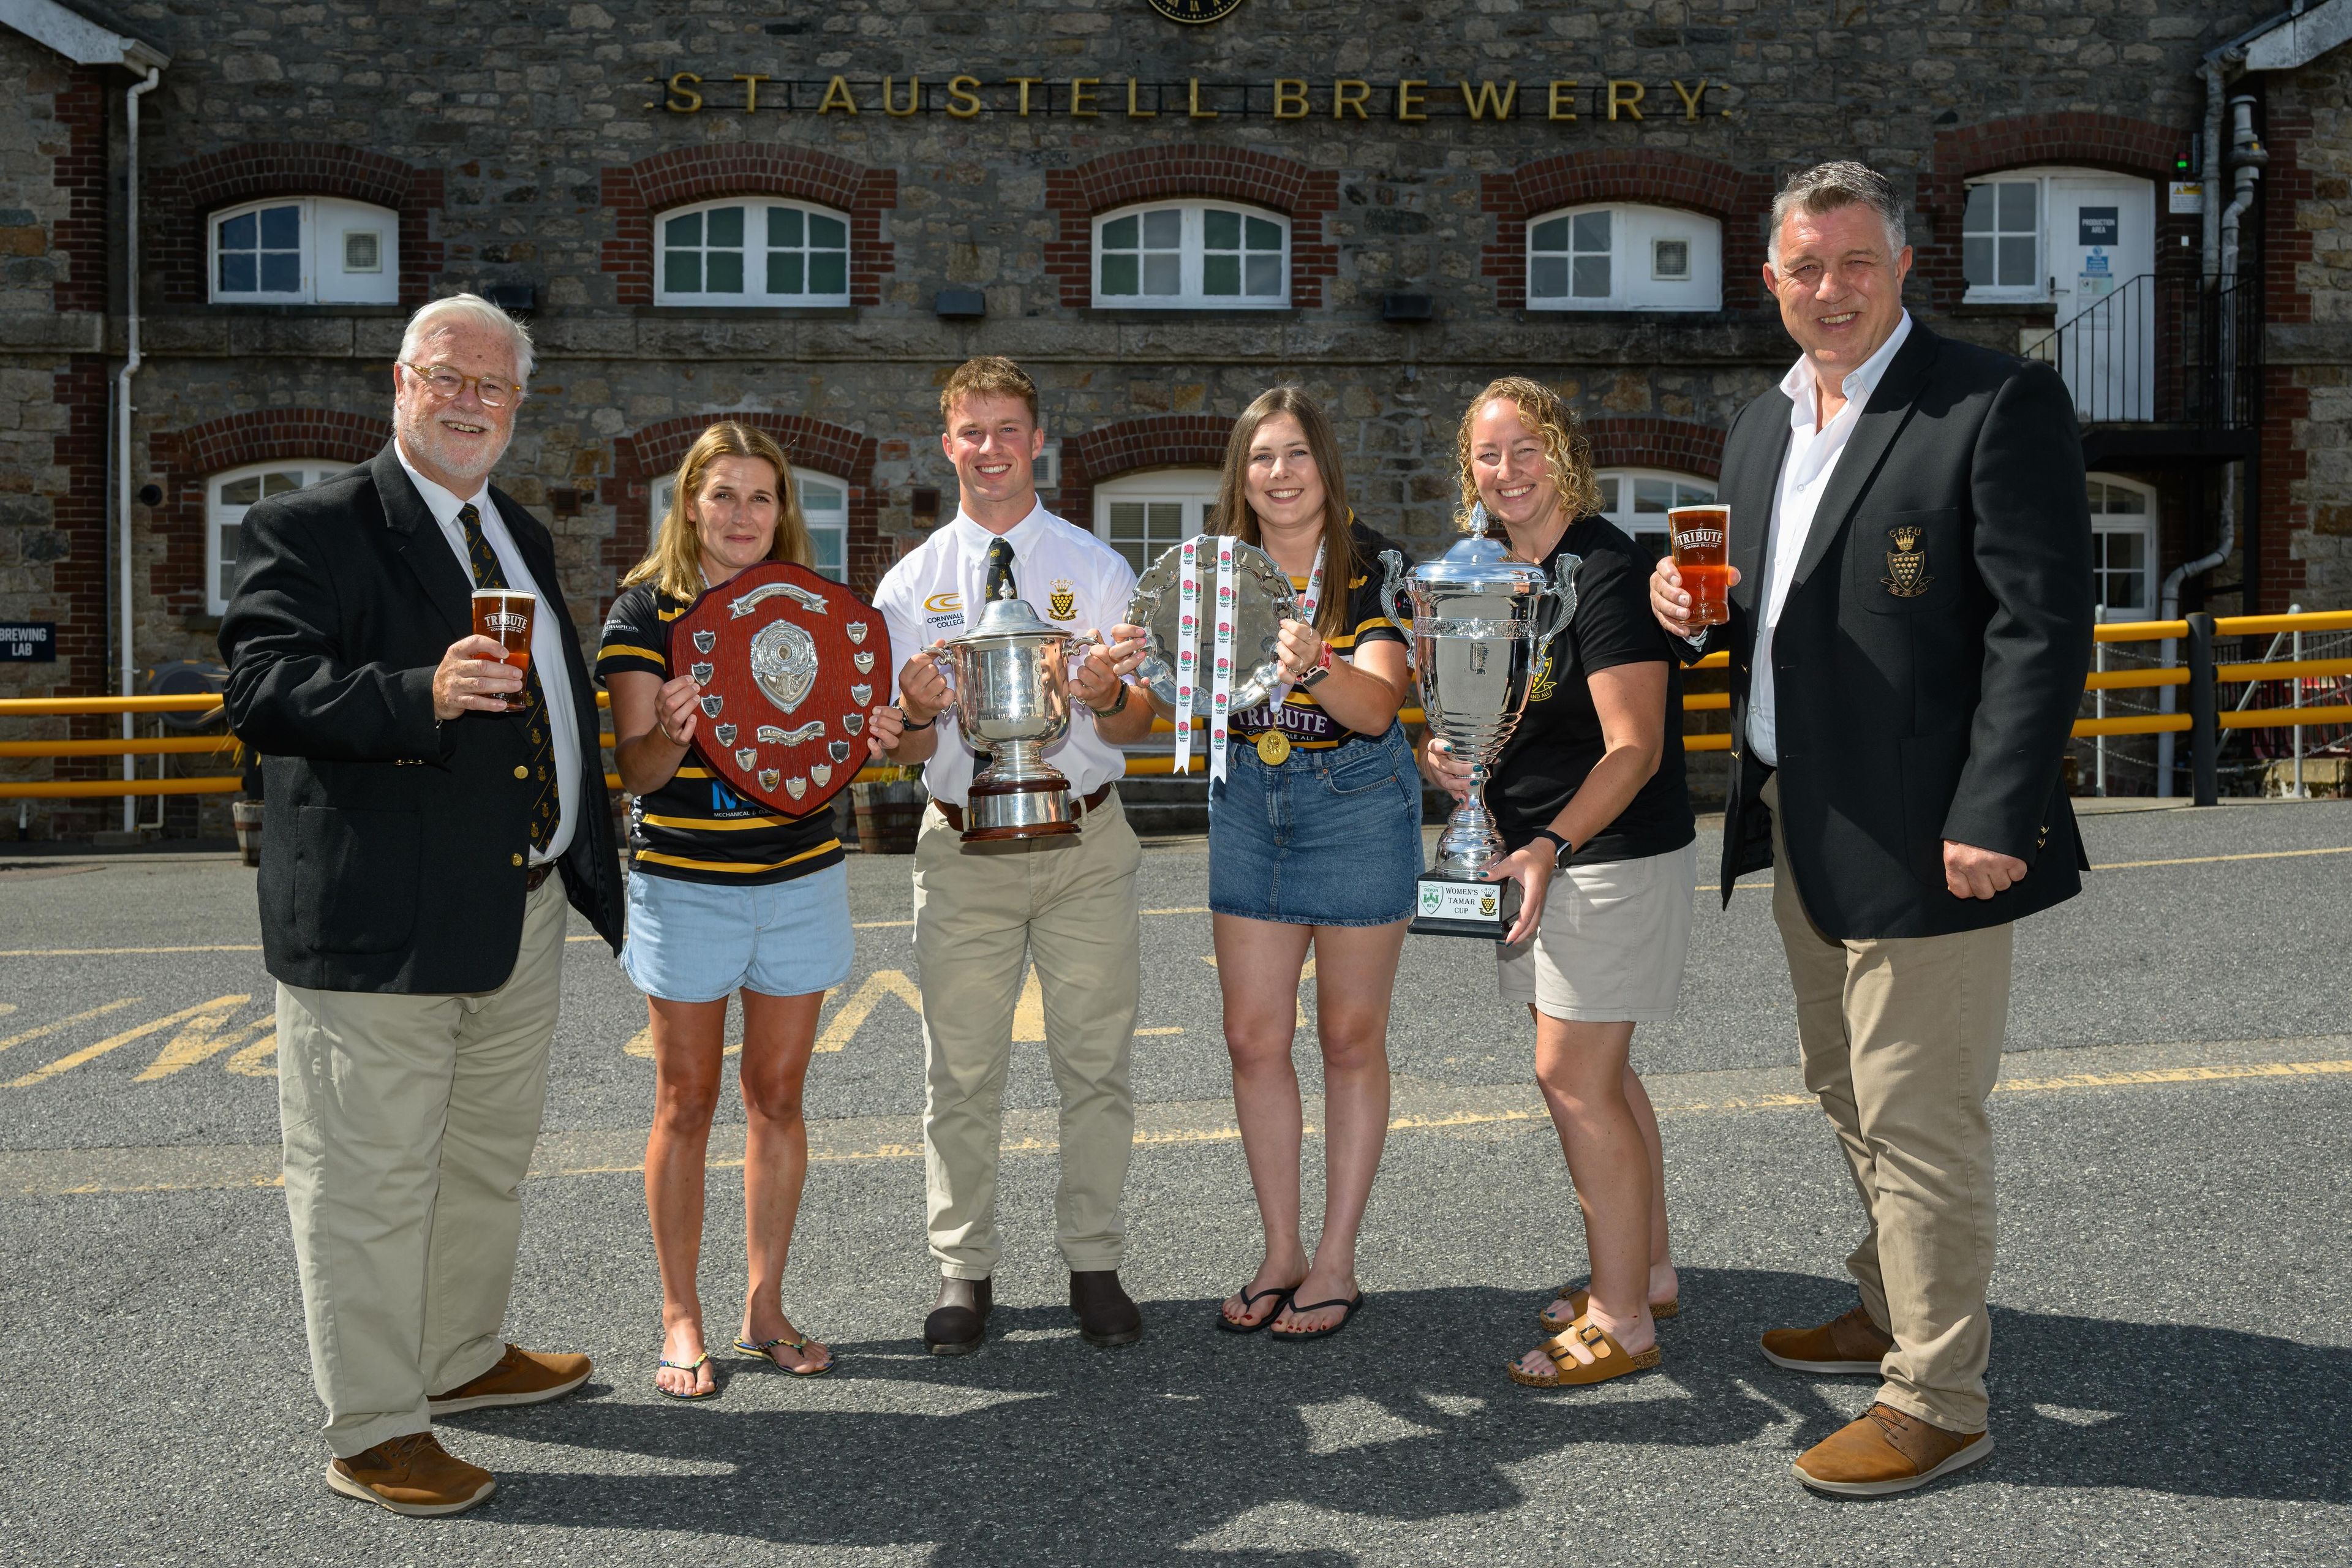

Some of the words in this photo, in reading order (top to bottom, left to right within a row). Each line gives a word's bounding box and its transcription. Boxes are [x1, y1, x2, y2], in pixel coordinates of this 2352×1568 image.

[666, 71, 771, 114] ST
[817, 74, 1218, 119] AUSTELL
[1273, 77, 1710, 122] BREWERY
[1677, 531, 1723, 545] TRIBUTE
[484, 614, 527, 629] TRIBUTE
[927, 612, 964, 624] CORNWALL
[937, 618, 965, 628] COLLEGE
[0, 627, 47, 642] BREWING
[12, 642, 32, 657] LAB
[1237, 706, 1327, 734] TRIBUTE
[1282, 731, 1298, 740] PALE
[1446, 887, 1478, 895] WOMEN'S
